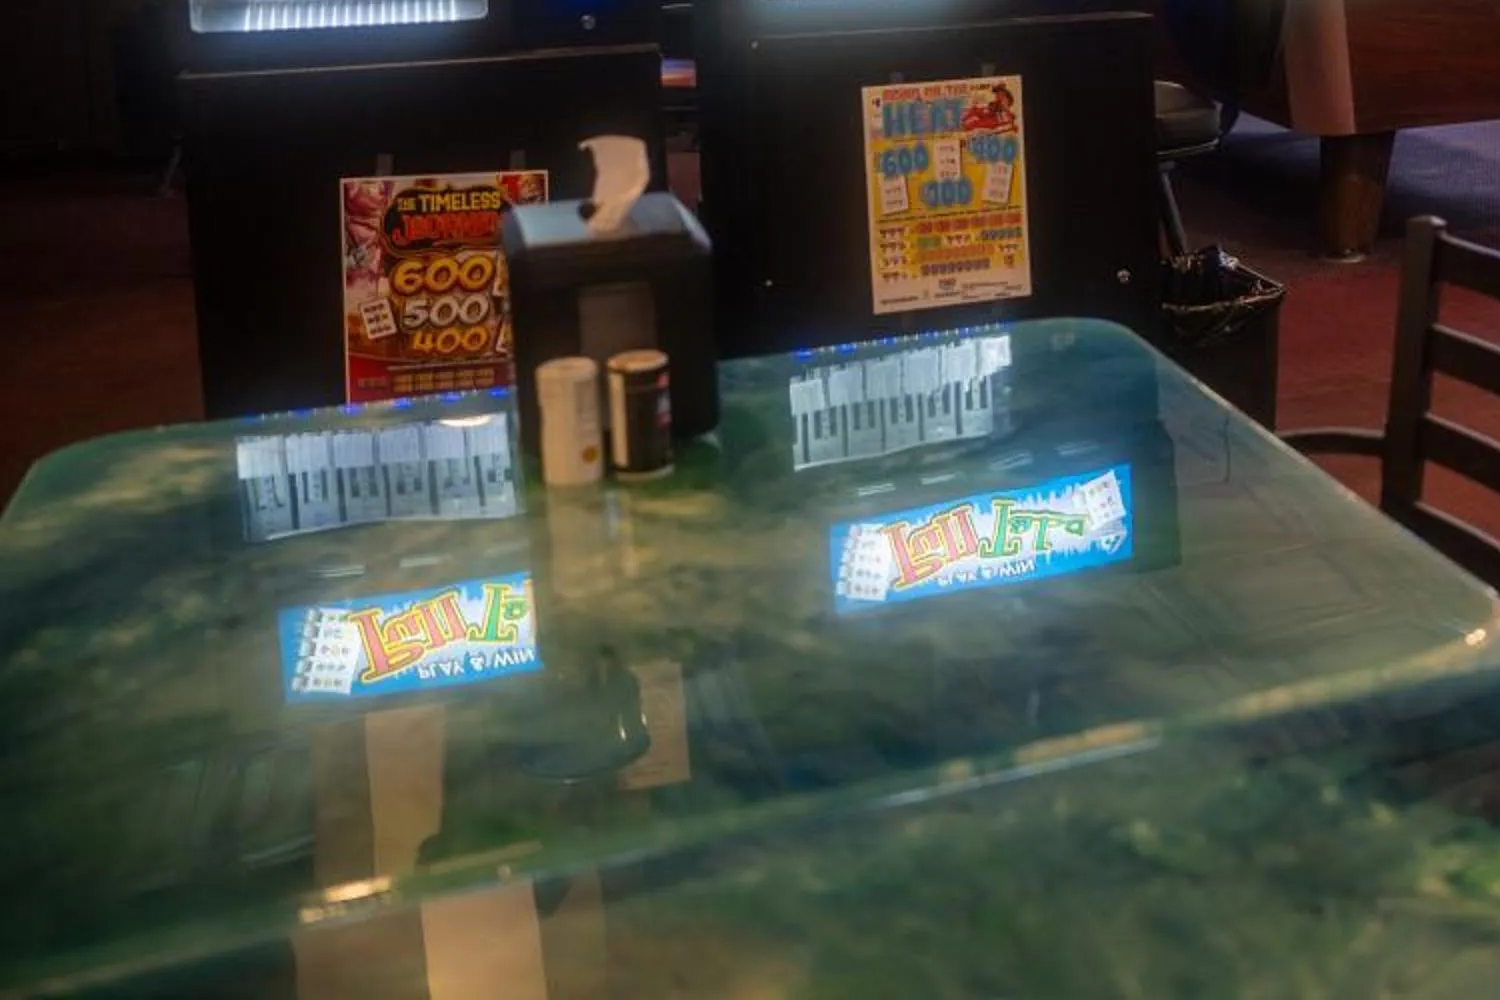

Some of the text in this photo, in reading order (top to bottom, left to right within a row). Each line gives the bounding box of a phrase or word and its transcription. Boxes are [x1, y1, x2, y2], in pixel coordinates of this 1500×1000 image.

[418, 191, 500, 212] TIMELESS
[394, 254, 493, 295] 600
[403, 296, 489, 329] 500
[413, 326, 488, 353] 400
